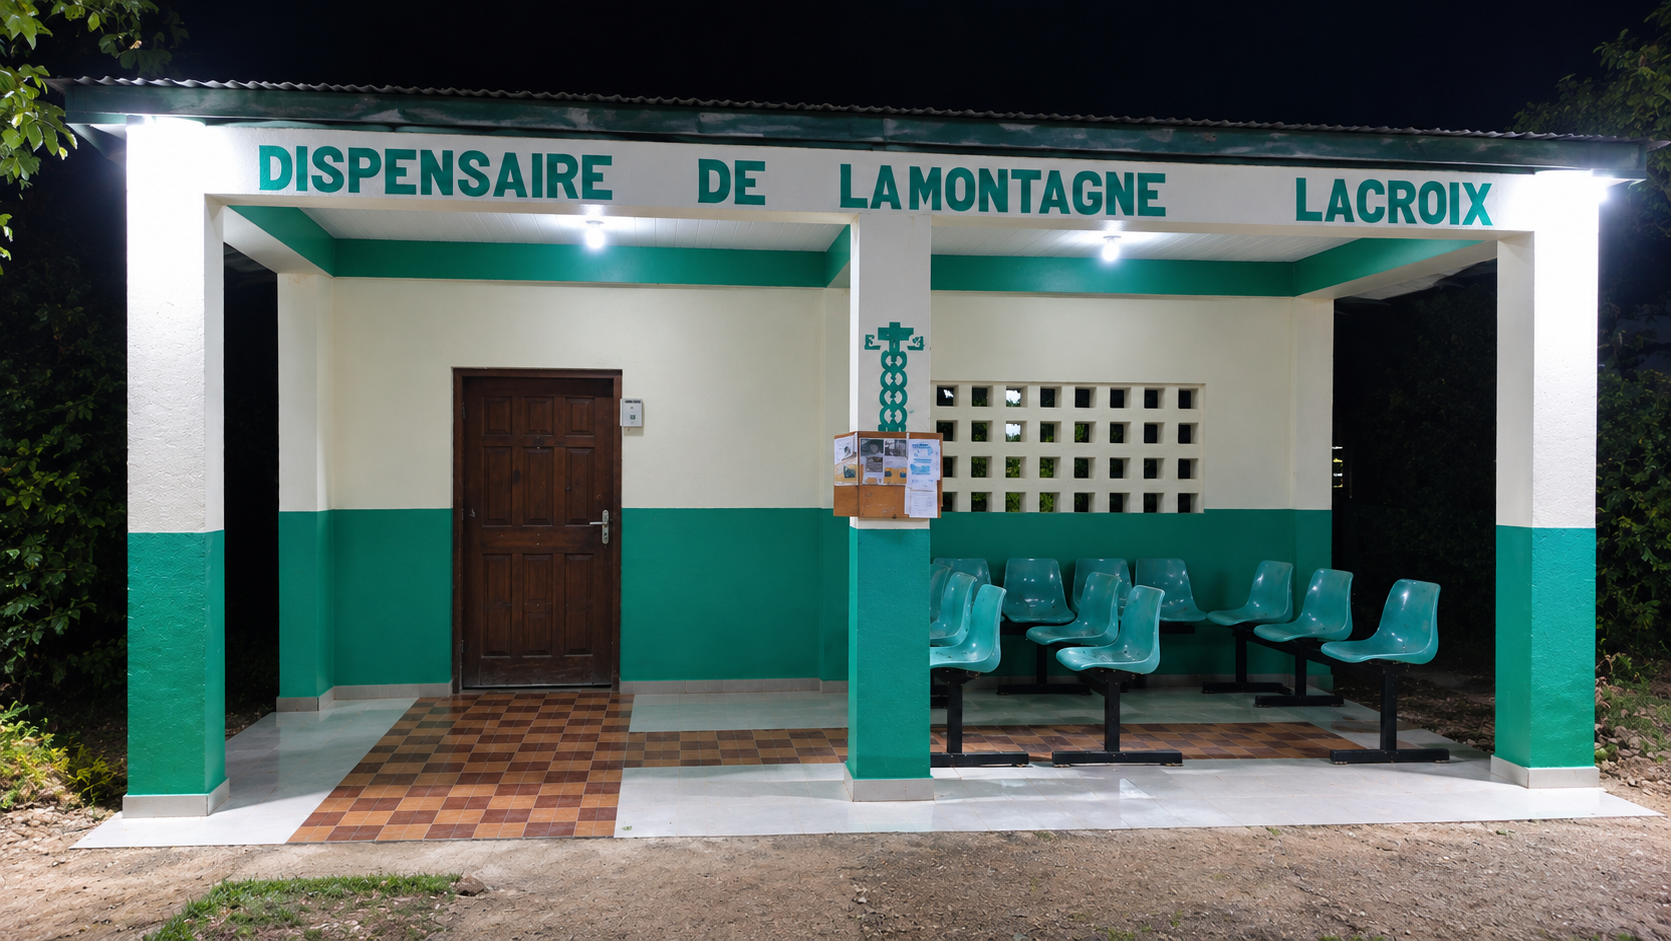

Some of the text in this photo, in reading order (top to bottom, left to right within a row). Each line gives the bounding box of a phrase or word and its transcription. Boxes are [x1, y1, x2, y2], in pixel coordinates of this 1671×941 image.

[259, 145, 1492, 225] DISPENSAIRE DE LAMONTAGNE LACROIX
